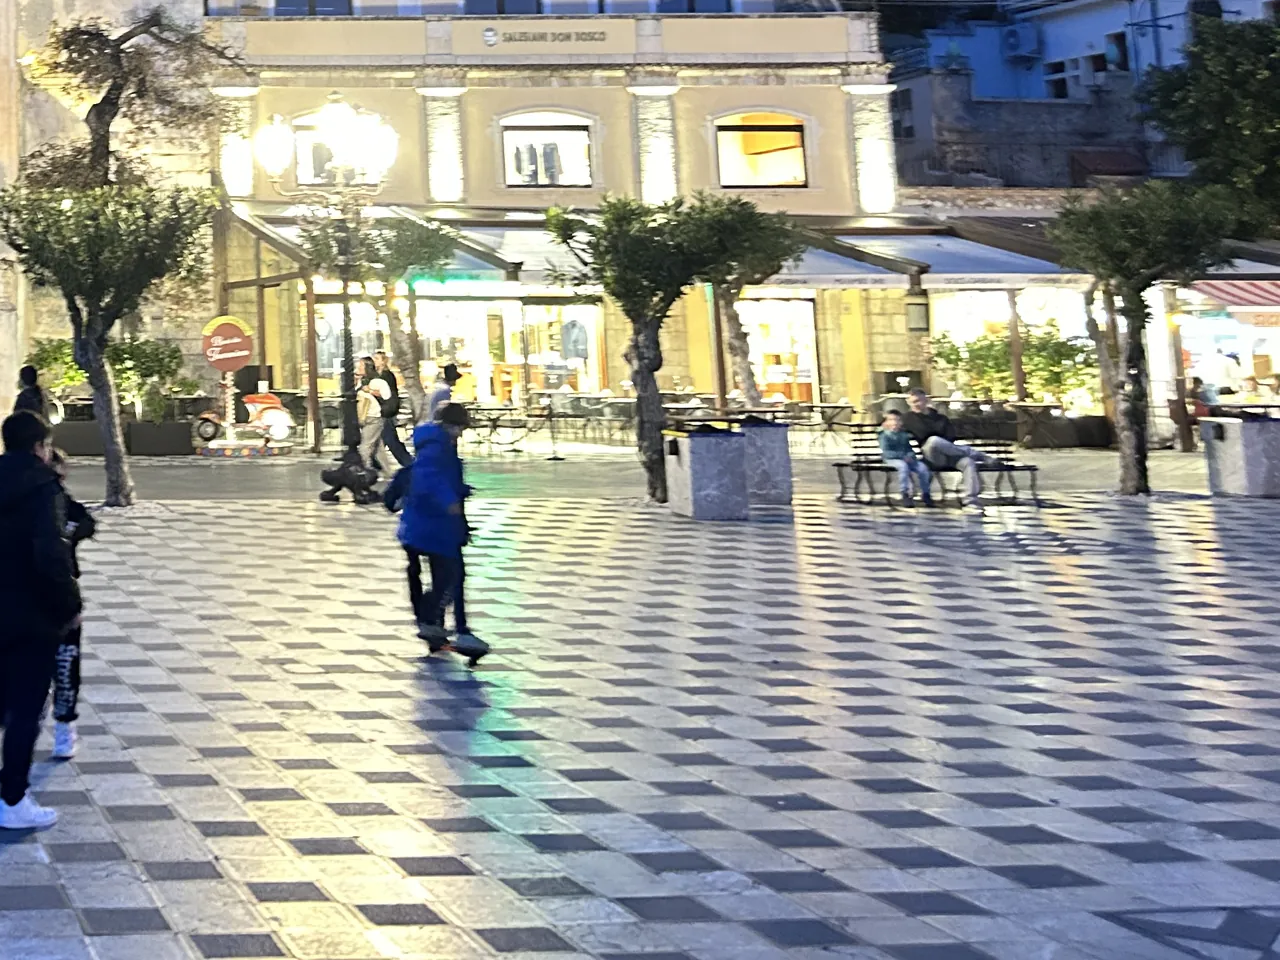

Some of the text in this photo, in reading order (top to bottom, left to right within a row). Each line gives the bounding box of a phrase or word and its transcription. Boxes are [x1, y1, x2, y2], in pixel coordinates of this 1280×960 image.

[502, 31, 607, 42] SALESIANI DON BOSCO
